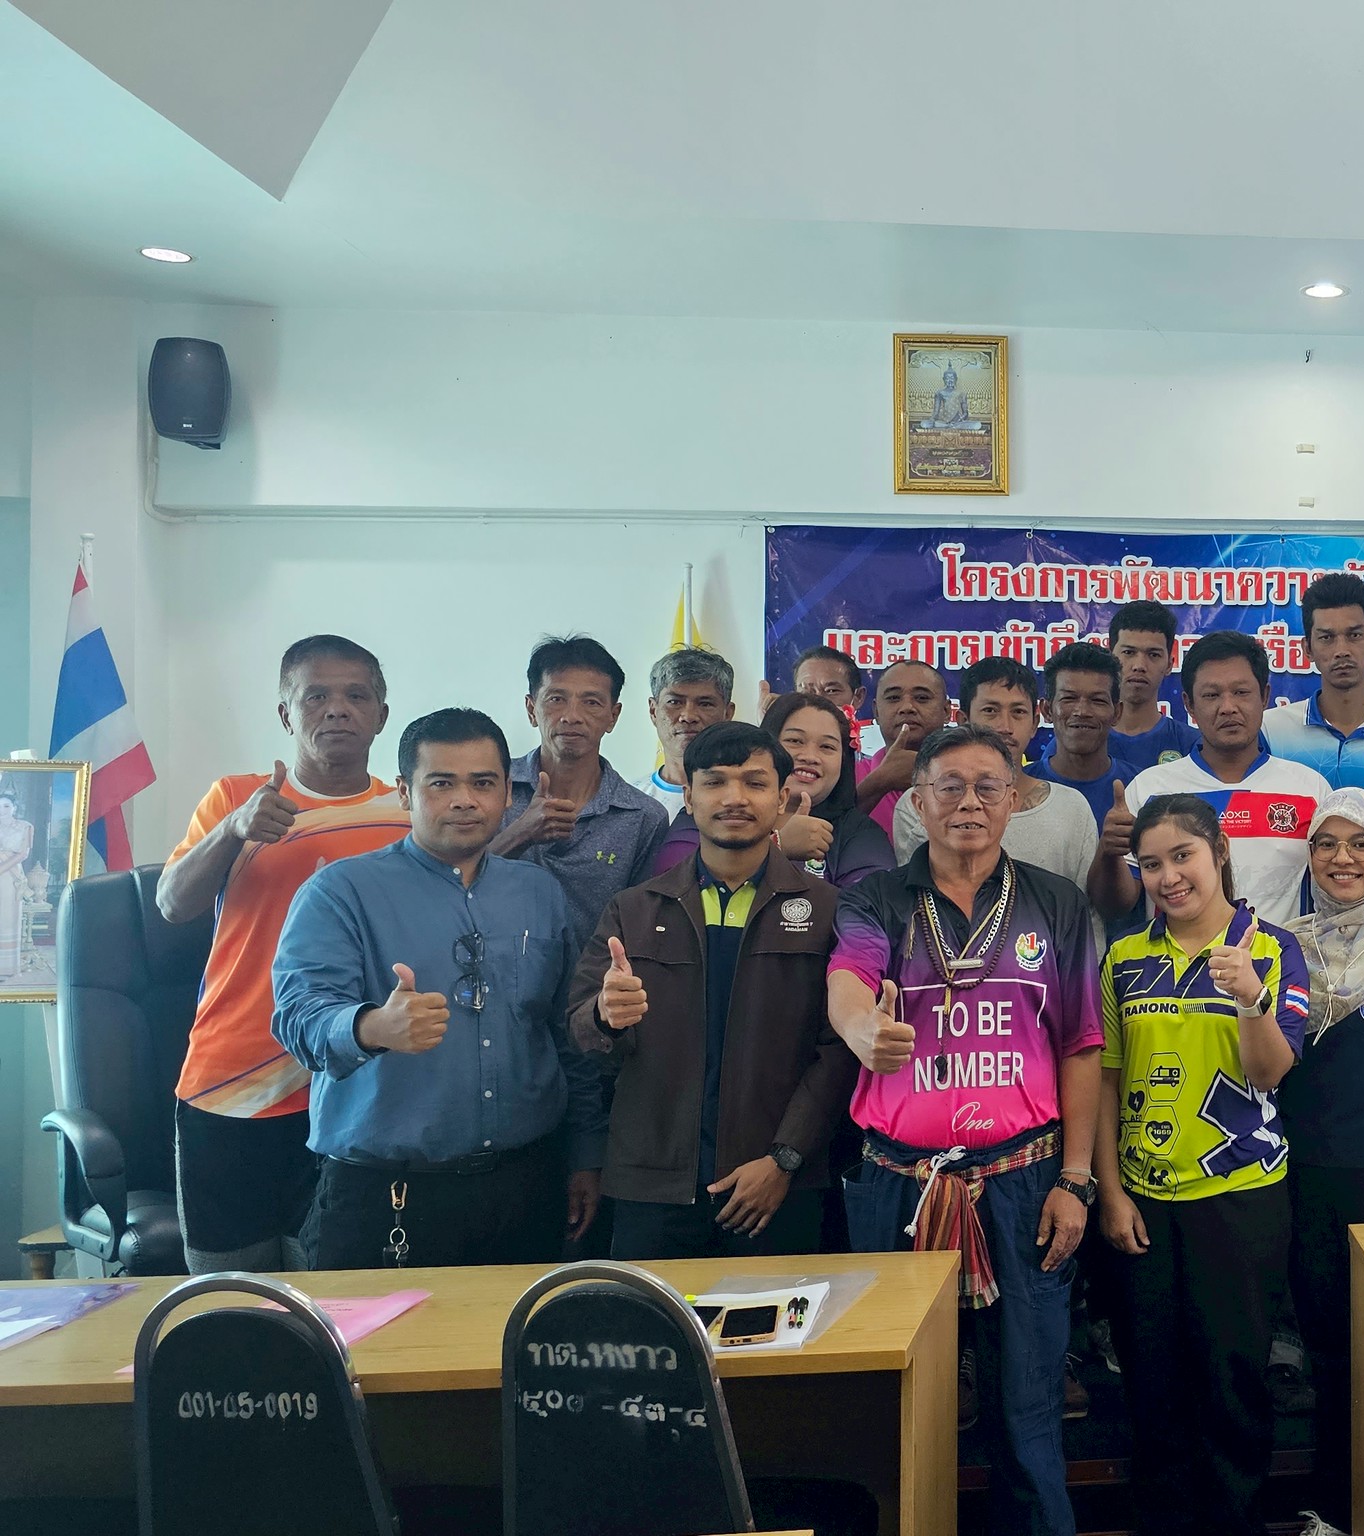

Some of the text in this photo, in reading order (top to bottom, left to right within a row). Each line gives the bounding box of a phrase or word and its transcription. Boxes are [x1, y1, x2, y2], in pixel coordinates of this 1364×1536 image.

[932, 1001, 1013, 1039] TO BE
[1124, 1003, 1179, 1018] RANONG
[914, 1051, 1024, 1093] NUMBER
[952, 1101, 995, 1133] One
